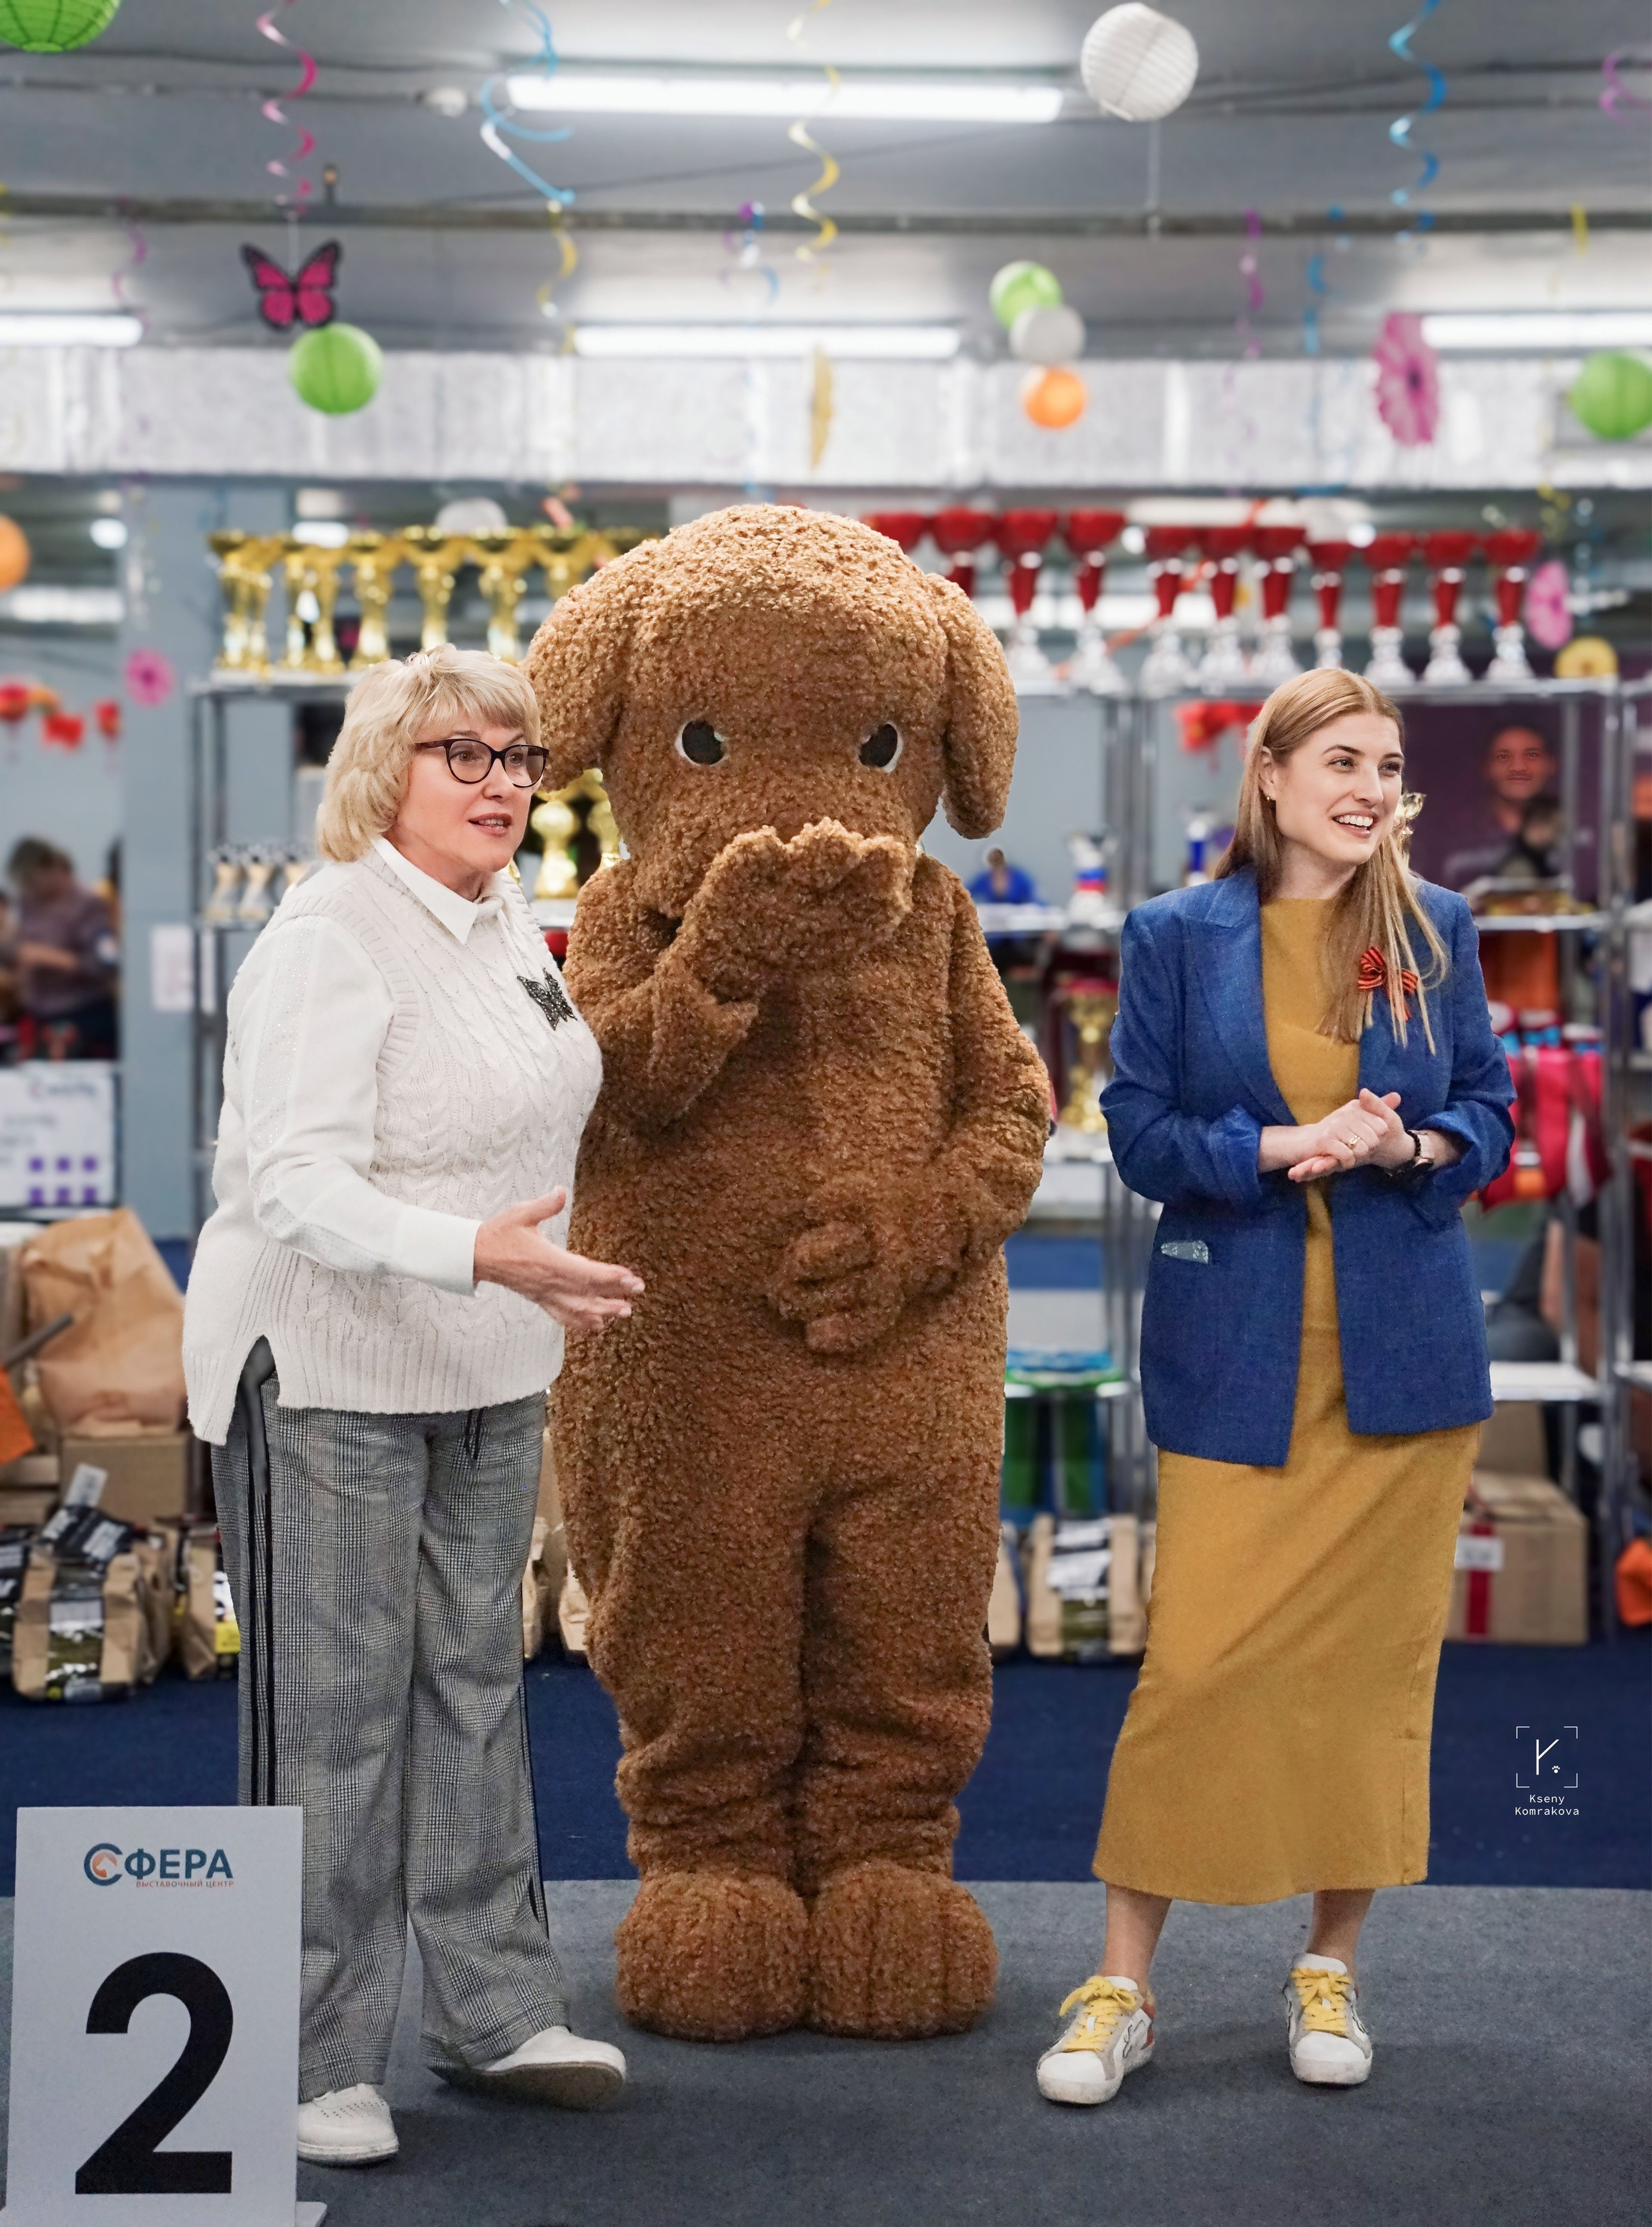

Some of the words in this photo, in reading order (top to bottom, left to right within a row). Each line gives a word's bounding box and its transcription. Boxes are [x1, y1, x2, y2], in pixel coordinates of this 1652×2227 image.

[84, 1843, 234, 1886] СФЕРА
[136, 1879, 203, 1887] ВЫСТАВОЧНЫЙ
[76, 1951, 233, 2195] 2
